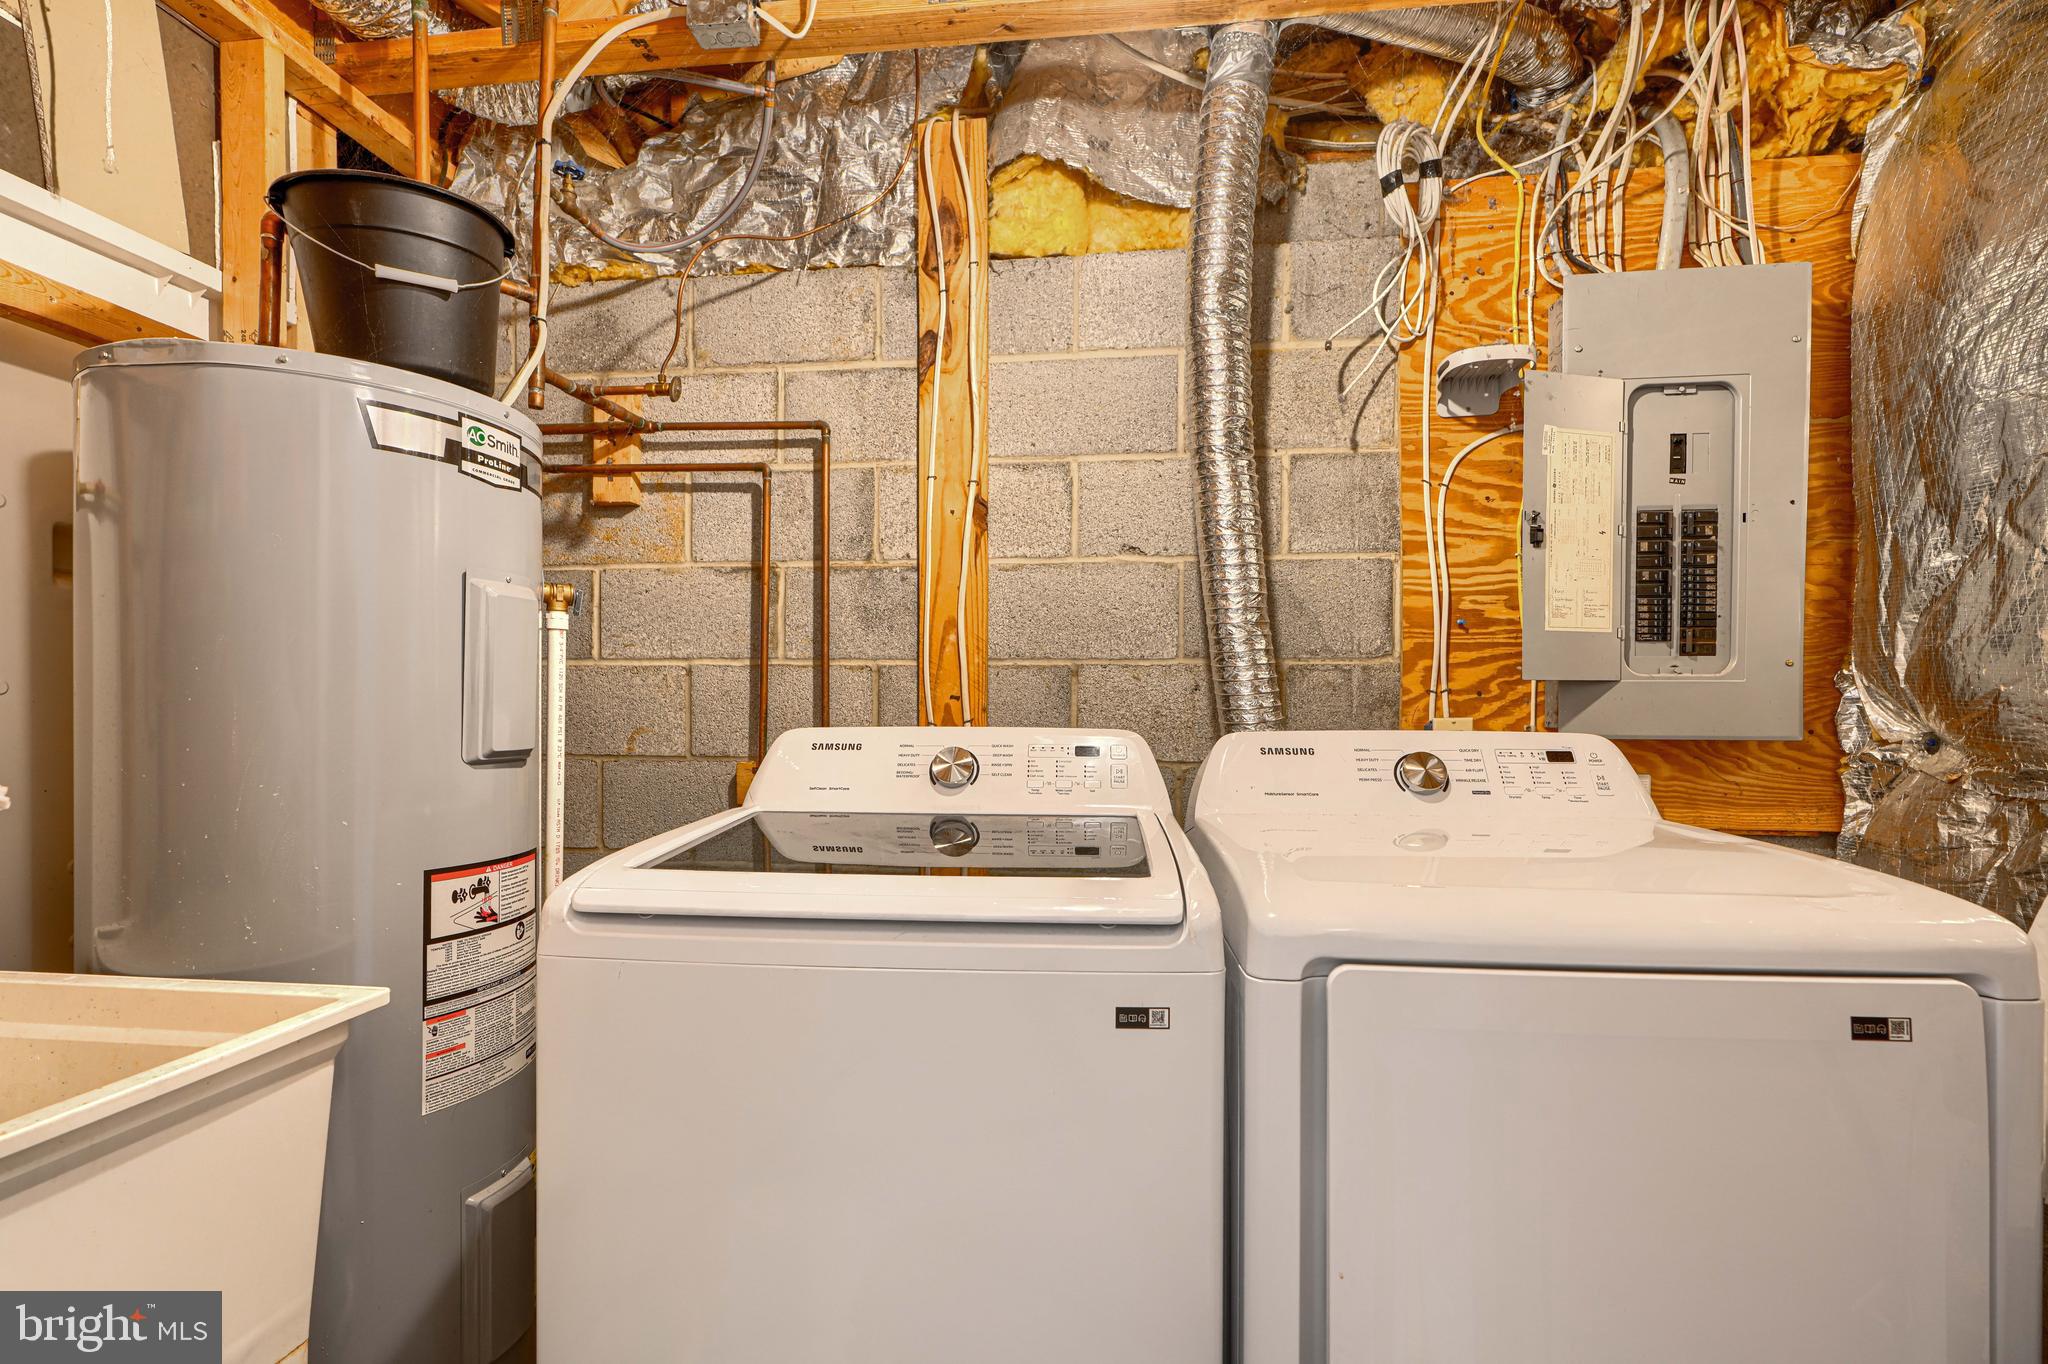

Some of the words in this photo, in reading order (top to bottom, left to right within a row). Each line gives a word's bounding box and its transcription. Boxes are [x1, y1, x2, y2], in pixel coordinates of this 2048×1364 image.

[487, 434, 518, 458] Smith
[477, 454, 512, 473] ProLine
[472, 467, 502, 480] COMMERCIAL
[811, 742, 863, 751] SAMSUNG
[1260, 747, 1315, 756] SAMSUNG
[492, 861, 514, 872] DANGER
